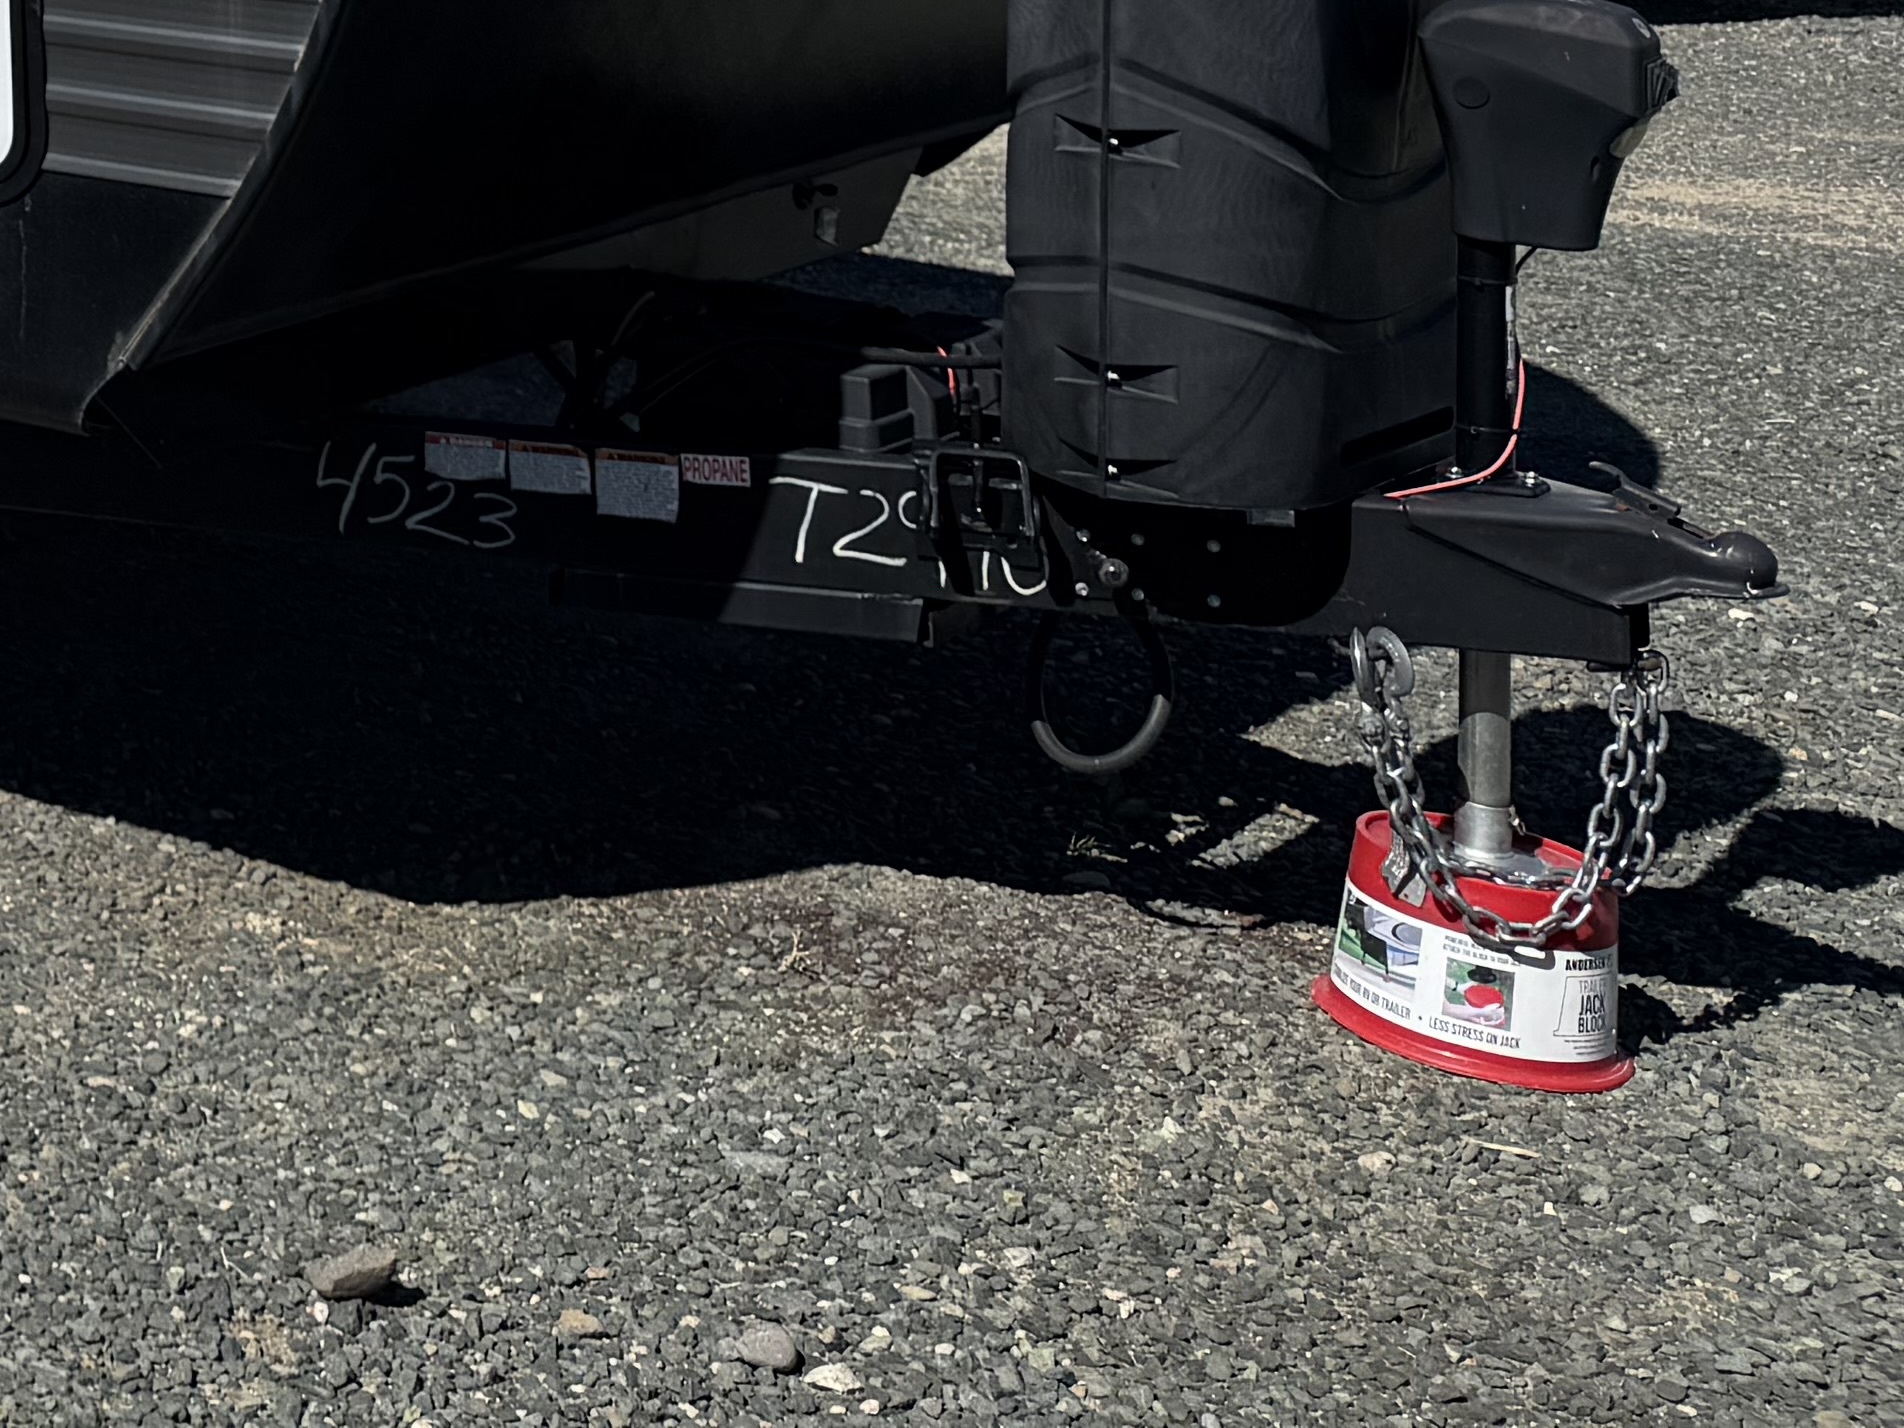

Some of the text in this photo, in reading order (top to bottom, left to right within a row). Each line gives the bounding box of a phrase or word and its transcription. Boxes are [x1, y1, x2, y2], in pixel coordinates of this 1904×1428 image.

[682, 456, 749, 484] PROPANE
[316, 440, 518, 549] 4523
[1428, 1015, 1522, 1049] LESS STRESS ON JACK
